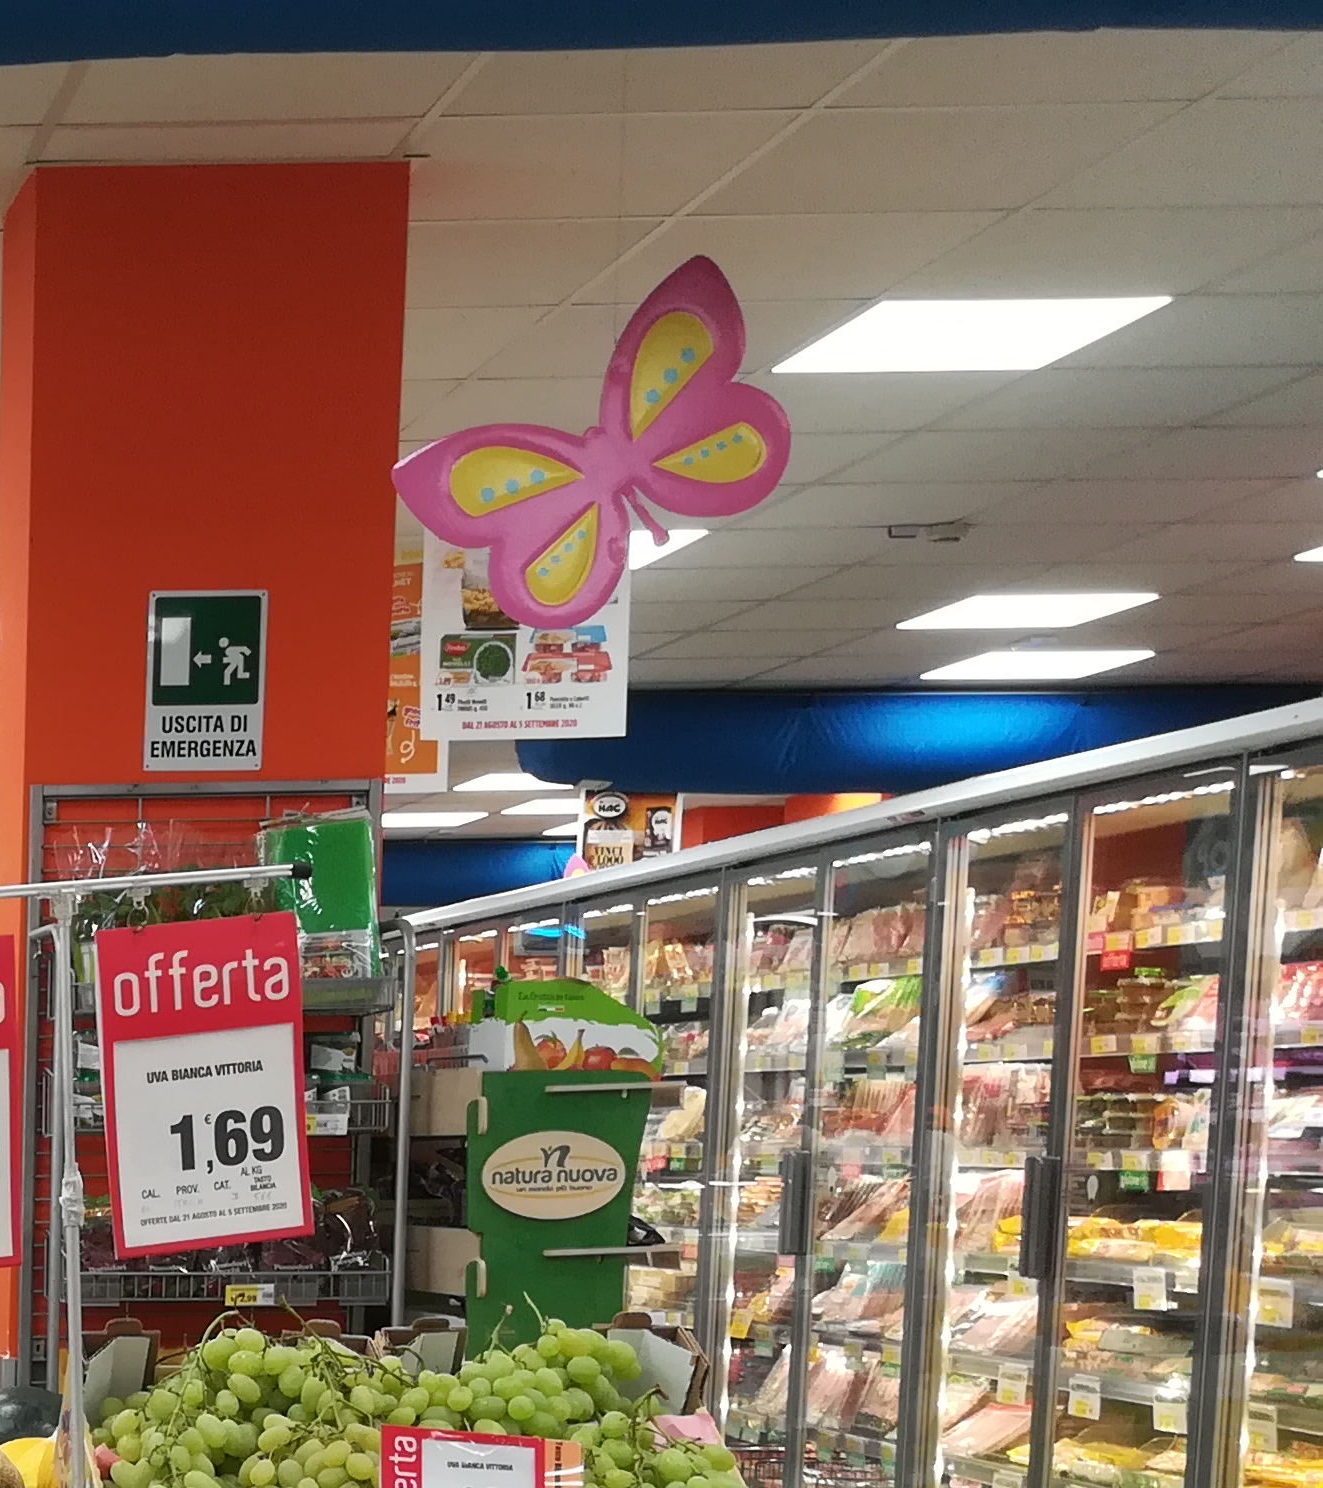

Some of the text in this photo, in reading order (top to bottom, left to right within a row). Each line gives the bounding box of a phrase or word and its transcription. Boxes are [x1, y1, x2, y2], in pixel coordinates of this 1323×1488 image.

[161, 714, 248, 733] USCITA DI
[150, 739, 257, 758] EMERGENZA
[113, 948, 290, 1017] offerta
[147, 1059, 264, 1084] UVA BIANCA VITTORIA
[491, 1167, 618, 1186] natura nuova
